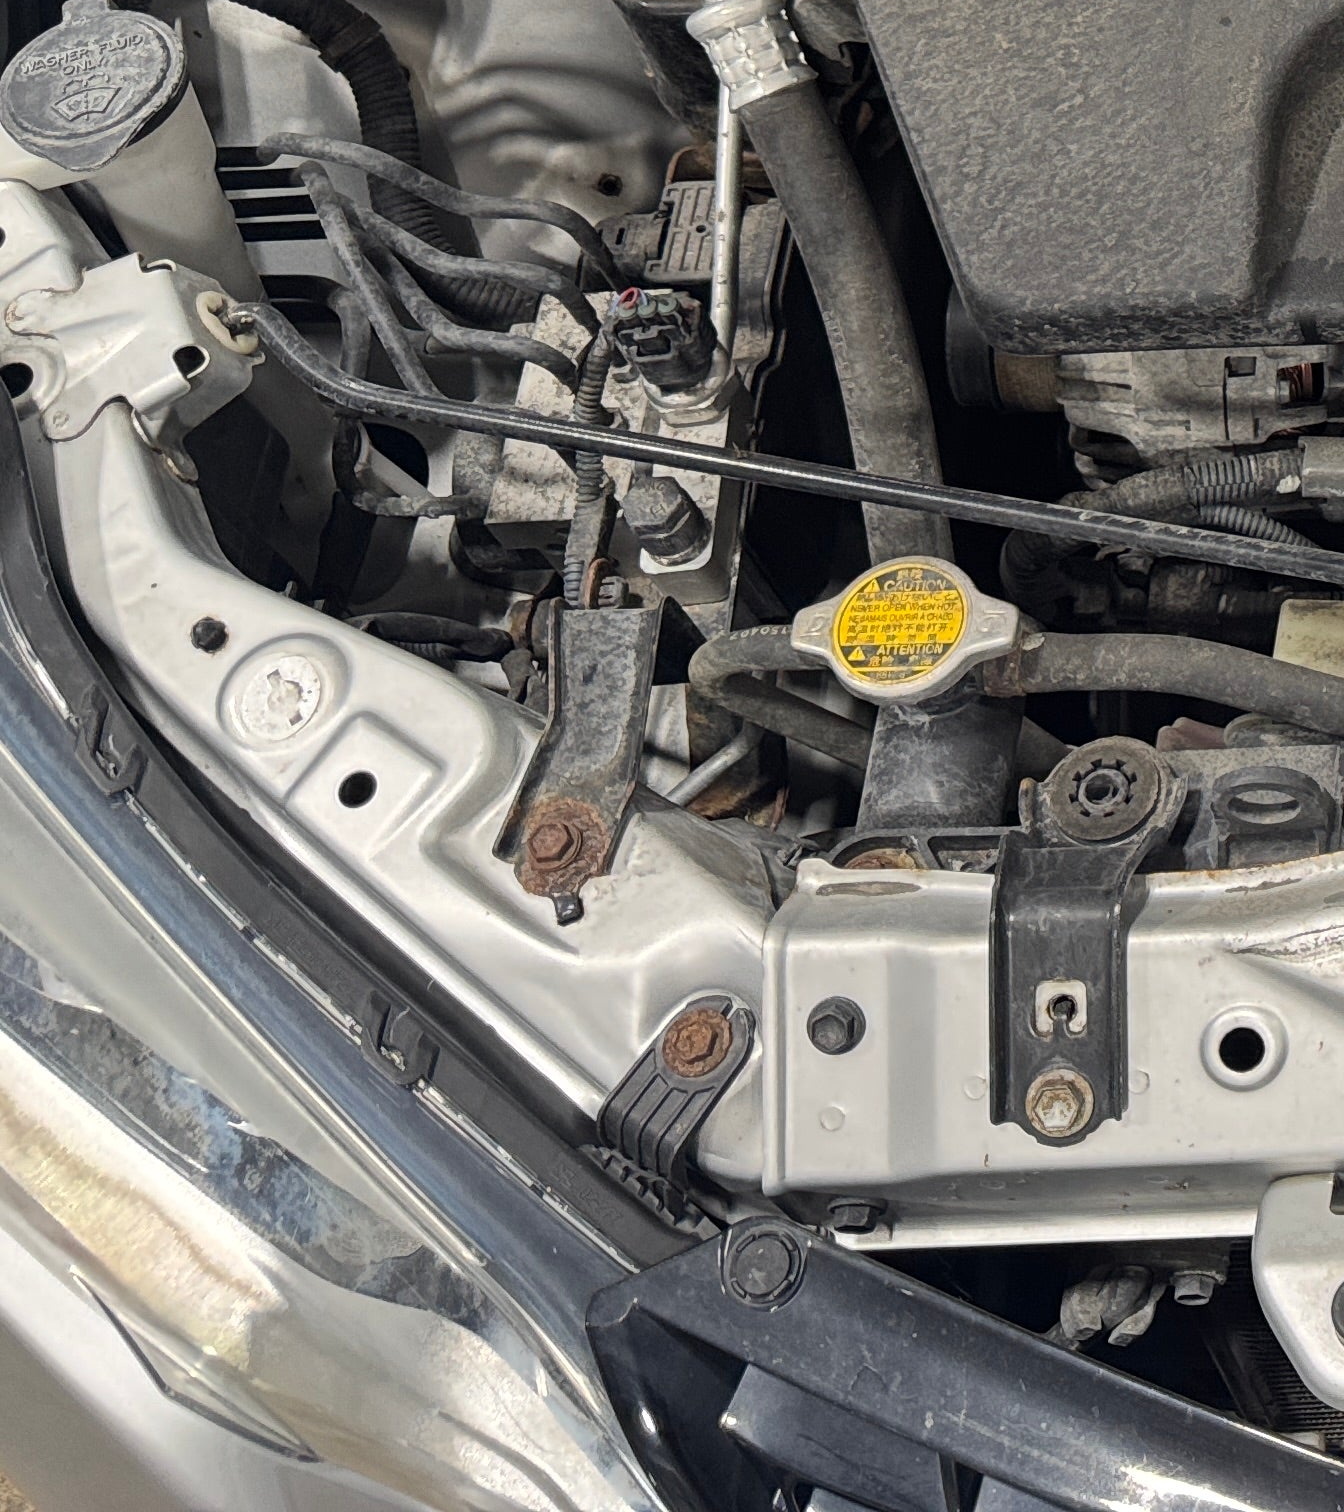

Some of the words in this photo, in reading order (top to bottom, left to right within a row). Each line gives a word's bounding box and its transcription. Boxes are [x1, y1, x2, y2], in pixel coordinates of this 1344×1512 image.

[20, 47, 91, 76] WASHER
[98, 34, 145, 55] FLUID
[62, 58, 109, 77] ONLY
[884, 580, 946, 592] CAUTION
[882, 604, 906, 612] OPEN
[876, 644, 943, 655] ATTENTION
